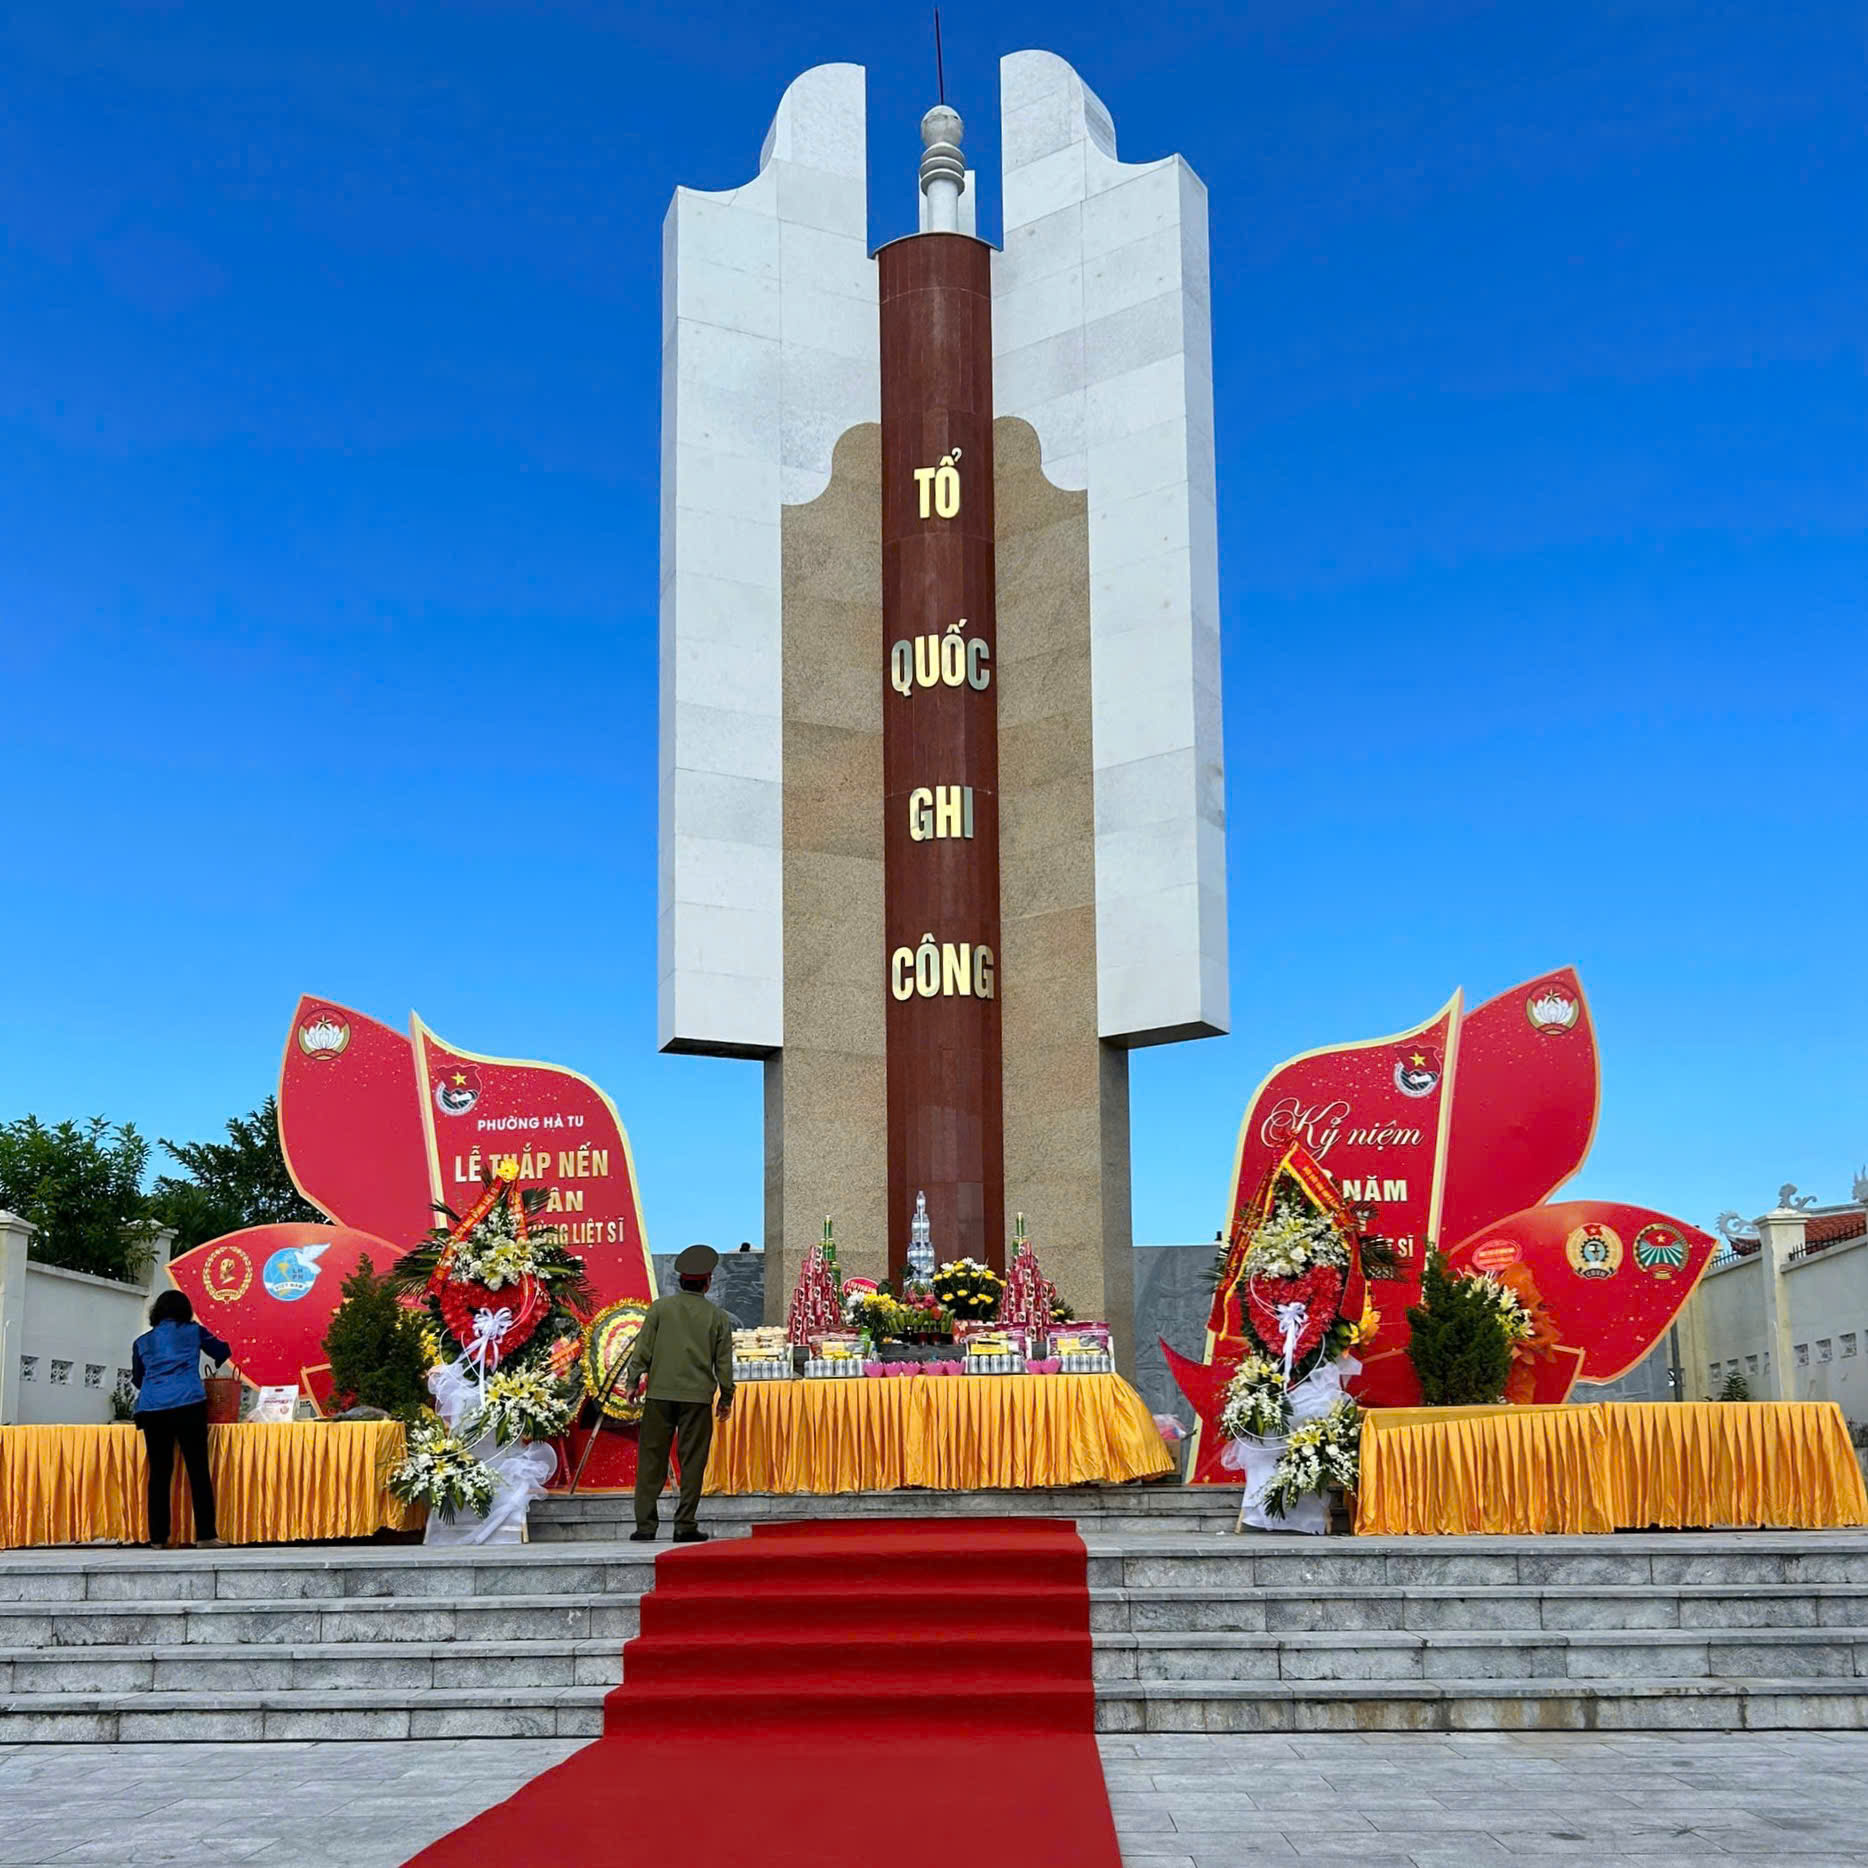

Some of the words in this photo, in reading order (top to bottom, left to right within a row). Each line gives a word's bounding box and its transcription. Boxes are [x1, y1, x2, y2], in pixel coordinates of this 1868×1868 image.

[914, 446, 962, 519] TỔ
[890, 618, 990, 697] QUỐC
[908, 785, 974, 842] GHI
[891, 932, 994, 1000] CÔNG
[477, 1115, 540, 1131] PHƯỜNG
[544, 1113, 564, 1129] HÀ
[568, 1115, 584, 1127] TU
[1261, 1097, 1350, 1161] Kỷ
[1347, 1120, 1424, 1151] niệm
[455, 1145, 482, 1182] LỄ
[489, 1142, 551, 1180] TẮP
[558, 1141, 609, 1178] NẾN
[546, 1187, 584, 1213] ÂN
[1342, 1175, 1407, 1202] NĂM
[573, 1218, 603, 1248] LIỆT
[607, 1217, 624, 1243] SĨ
[1398, 1234, 1414, 1257] SĨ
